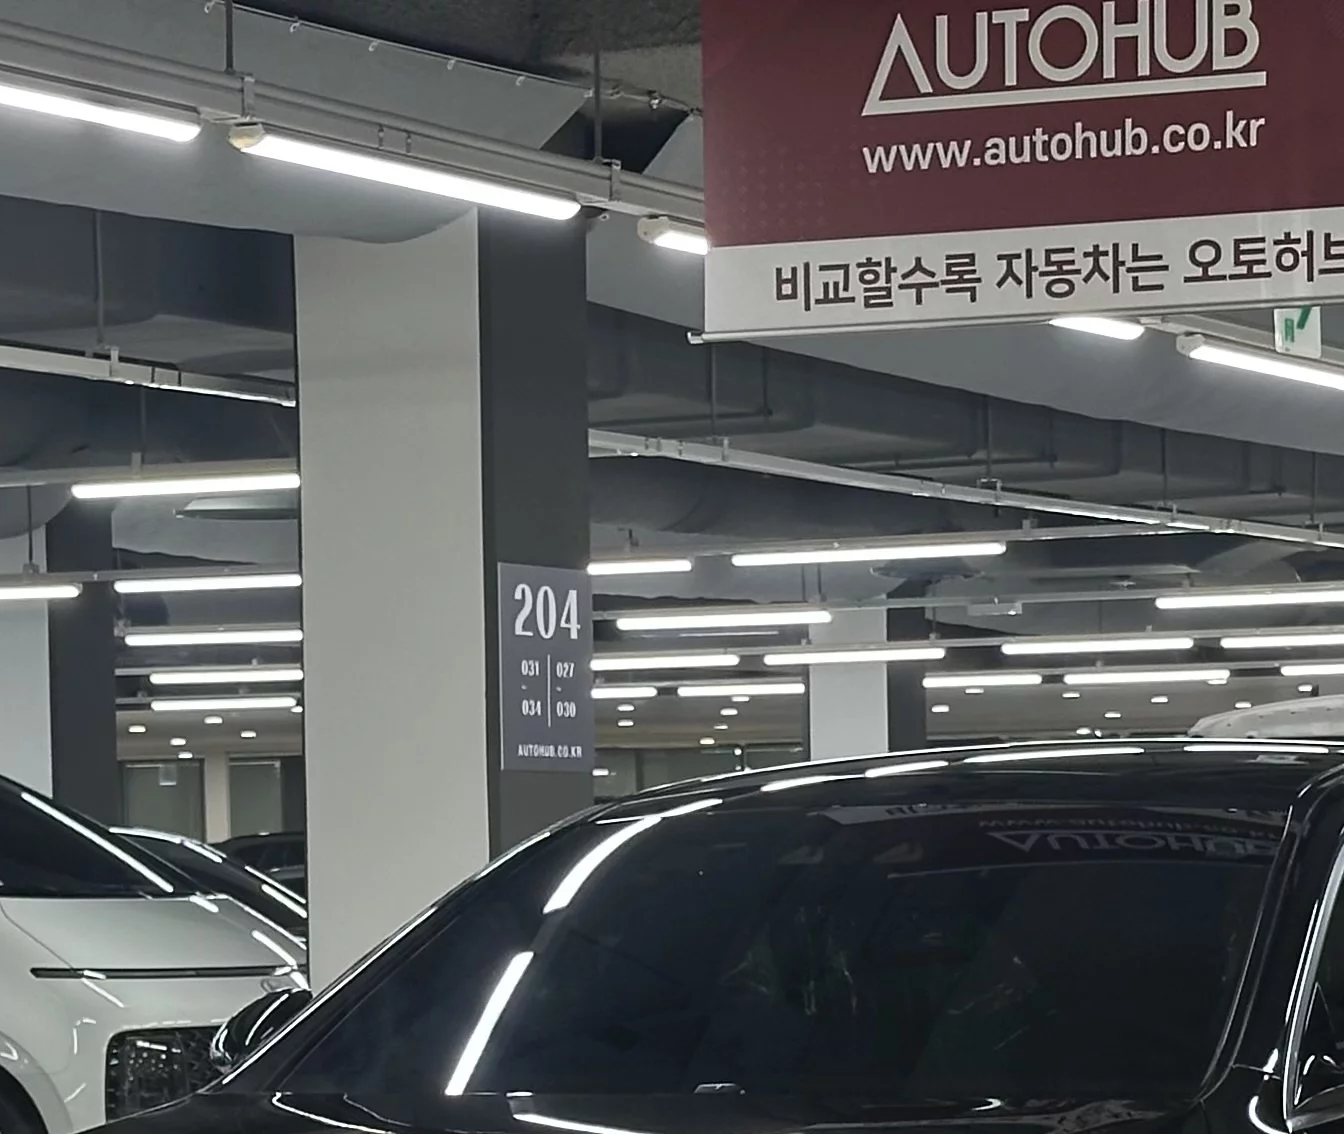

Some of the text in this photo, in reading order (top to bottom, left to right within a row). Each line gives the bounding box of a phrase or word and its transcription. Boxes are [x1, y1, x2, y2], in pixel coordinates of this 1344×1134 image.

[862, 0, 1266, 116] AUTOHUB
[862, 110, 1266, 174] www.autohub.co.kr
[775, 254, 982, 312] 비교할수록
[995, 241, 1170, 301] 자동차는
[514, 583, 581, 640] 204
[521, 660, 540, 676] 031
[556, 661, 575, 678] 027
[522, 699, 542, 716] 034
[556, 701, 576, 718] 030
[517, 744, 582, 758] AUTOHUB.CO.KR
